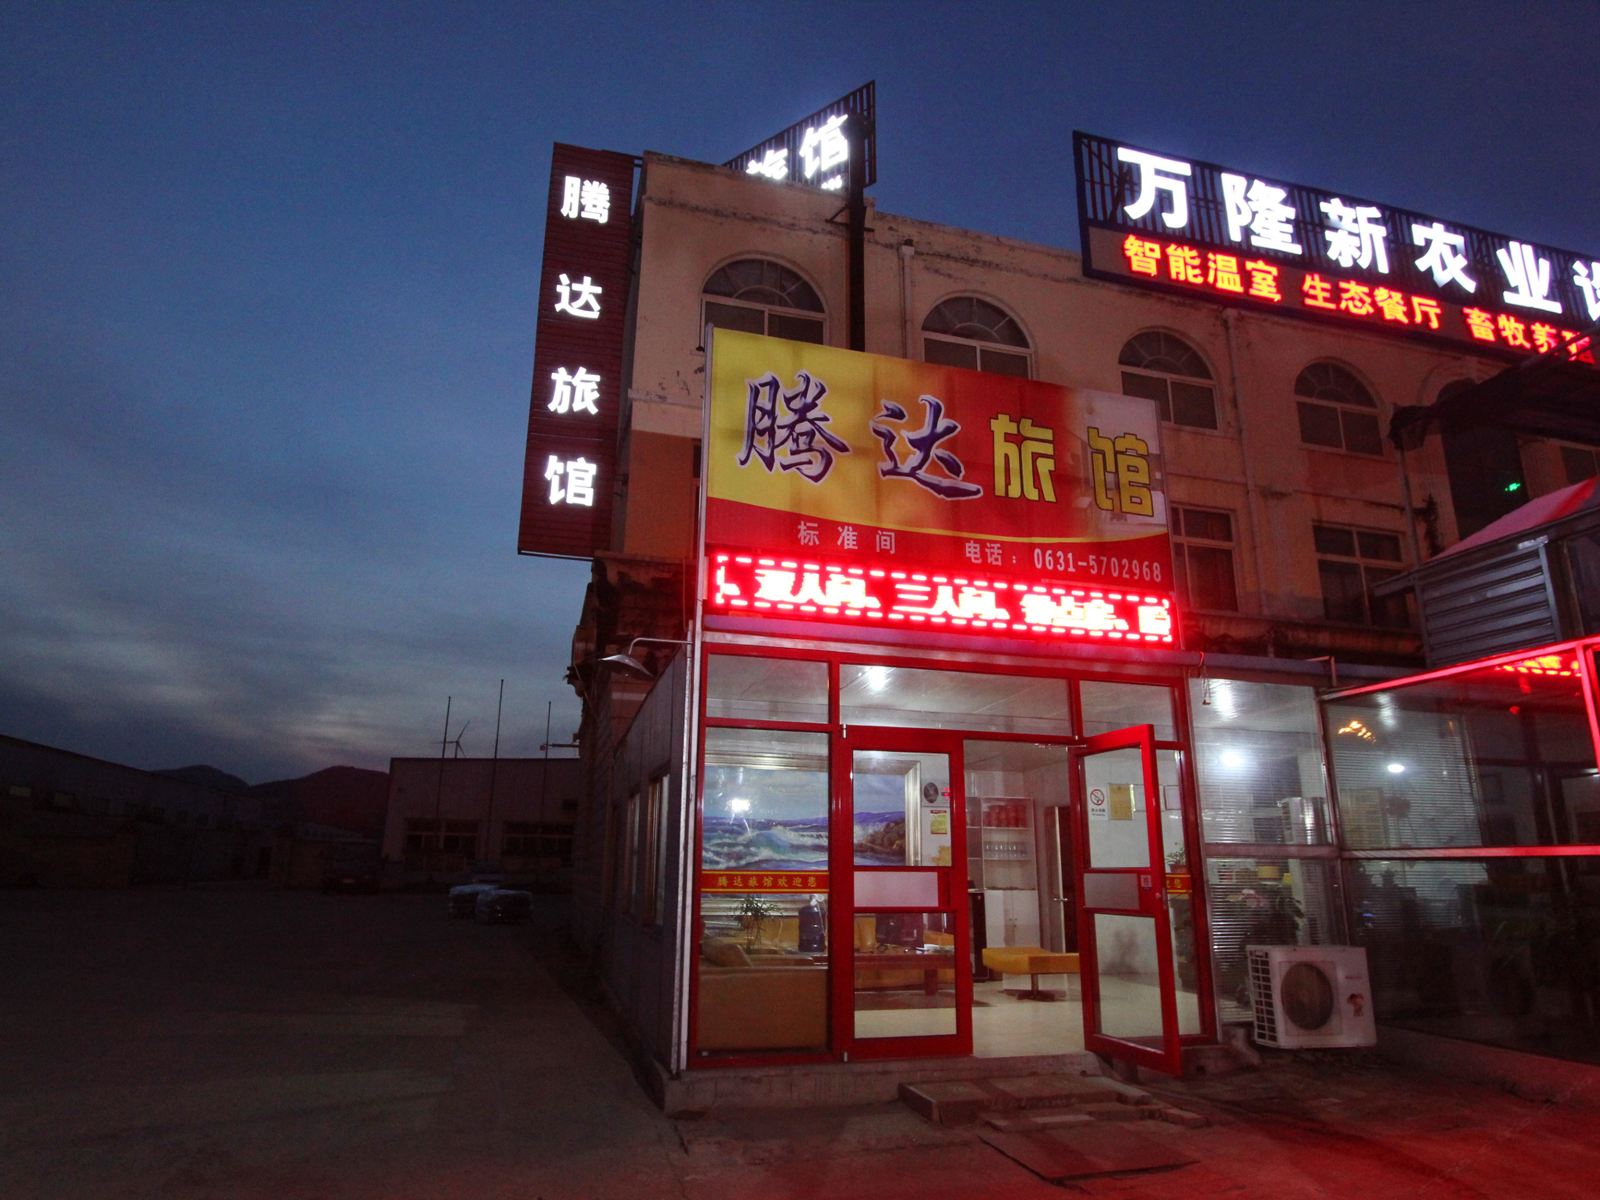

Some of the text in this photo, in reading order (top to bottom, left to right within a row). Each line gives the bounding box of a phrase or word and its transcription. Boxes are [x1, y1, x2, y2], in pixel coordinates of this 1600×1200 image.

[543, 175, 611, 507] 腾达旅馆
[1123, 233, 1282, 302] 智能温室
[1301, 272, 1443, 330] 生态餐厅
[738, 368, 1155, 518] 腾达旅馆
[797, 520, 896, 554] 标准间
[1033, 546, 1162, 583] 0631-5702968
